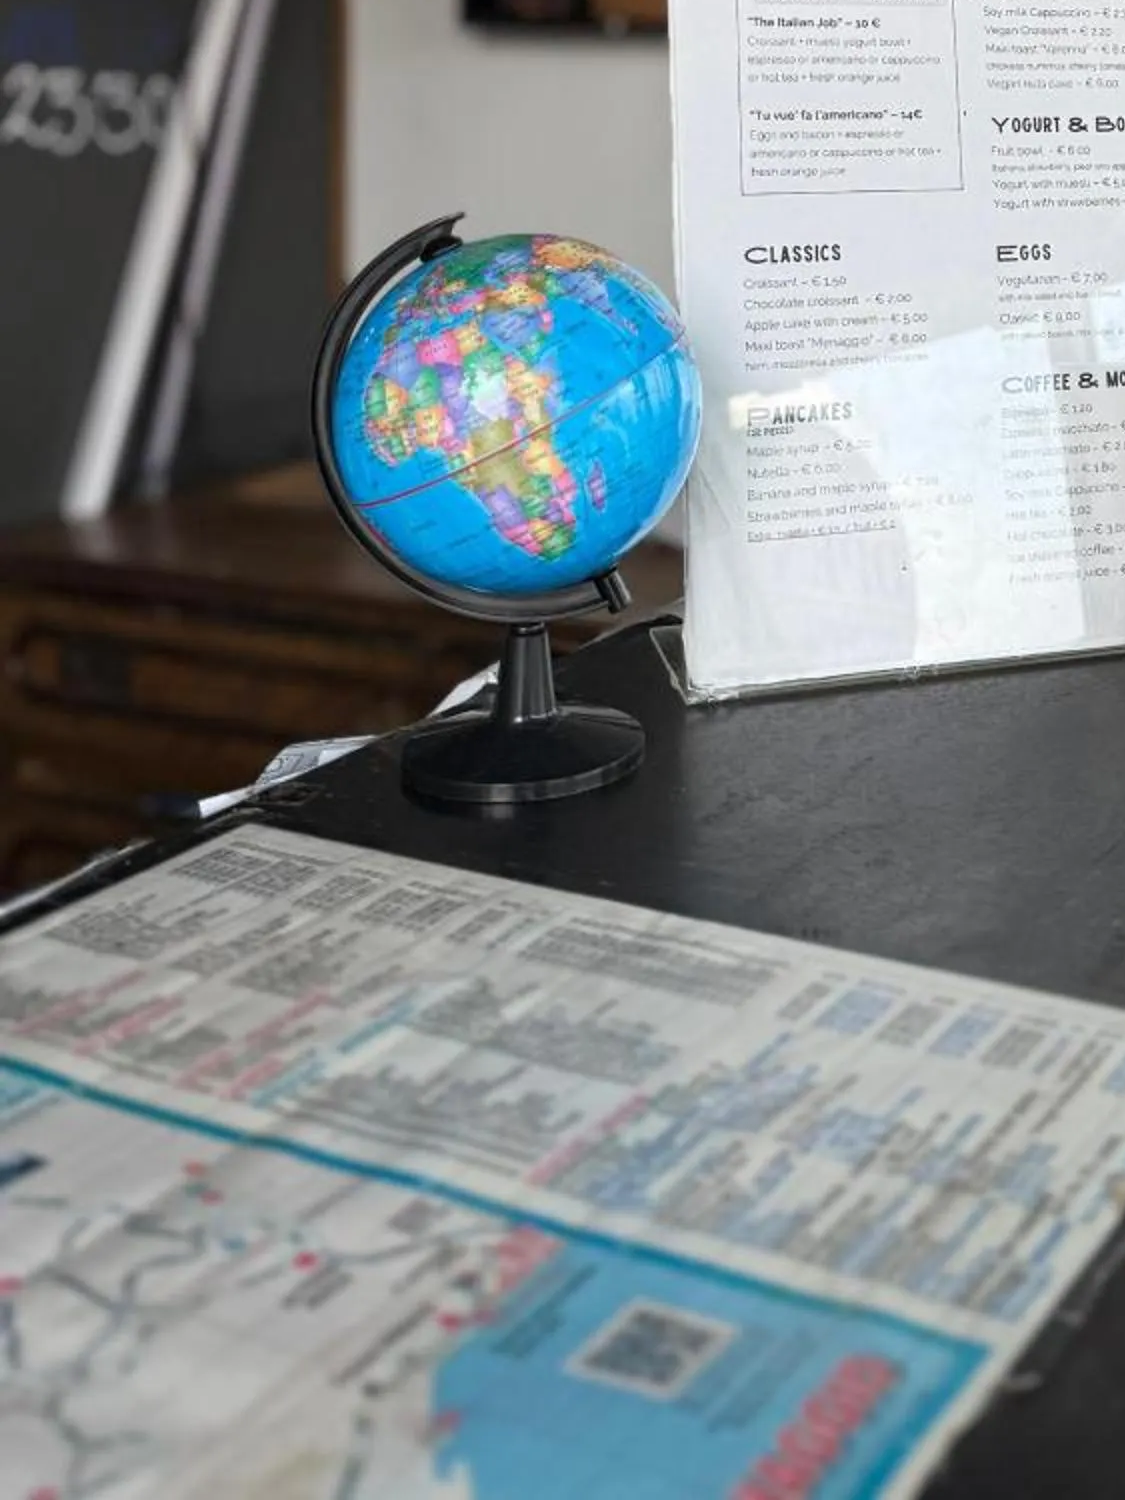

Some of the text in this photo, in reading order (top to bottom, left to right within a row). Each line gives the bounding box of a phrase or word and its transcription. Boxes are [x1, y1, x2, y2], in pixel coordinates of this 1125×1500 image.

[983, 7, 1001, 19] Soy
[1030, 7, 1091, 20] Cappuccino
[777, 17, 814, 28] Italian
[871, 18, 881, 28] €
[984, 25, 1019, 38] Vegan
[1022, 25, 1069, 36] Croissant
[747, 36, 796, 47] Croissant
[843, 37, 877, 49] yogurt
[837, 73, 875, 85] orange
[991, 117, 1060, 133] YOGURT
[1068, 117, 1089, 133] &
[750, 129, 775, 141] Eggs
[992, 179, 1028, 191] Yogurt
[993, 198, 1030, 210] Yogurt
[1033, 197, 1054, 207] with
[744, 244, 841, 265] CLASSICS
[996, 244, 1051, 262] EGGS
[743, 277, 797, 290] Croissant
[811, 276, 821, 287] €
[744, 298, 805, 311] Chocolate
[744, 320, 780, 332] Apple
[1002, 373, 1071, 394] COFFEE
[1078, 372, 1099, 389] &
[747, 401, 853, 426] PANCAKES
[1060, 404, 1069, 414] €
[1094, 524, 1103, 535] €
